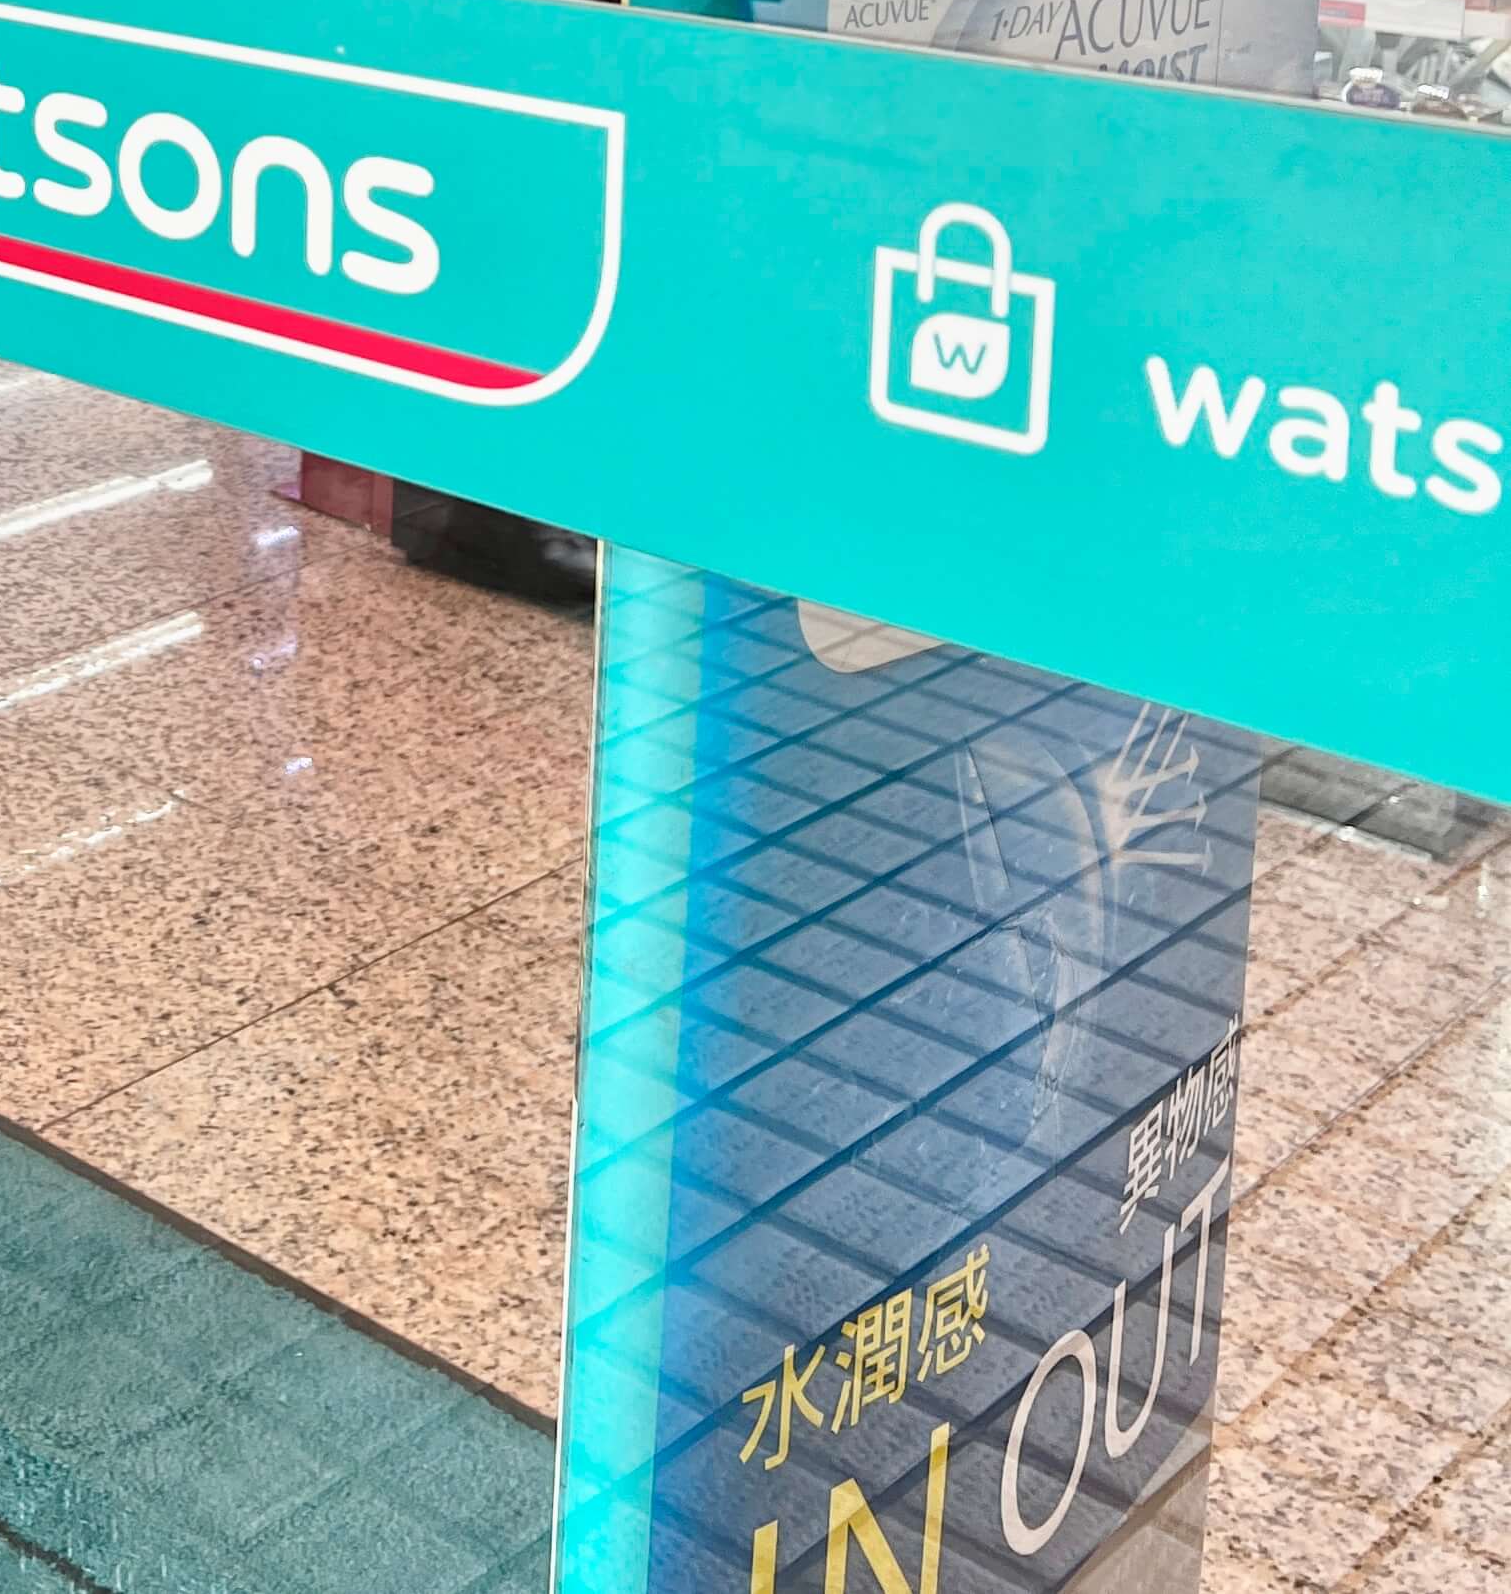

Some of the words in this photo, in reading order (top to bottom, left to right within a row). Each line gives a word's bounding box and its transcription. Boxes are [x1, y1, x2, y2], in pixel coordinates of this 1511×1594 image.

[1097, 42, 1210, 85] OIST
[1145, 355, 1504, 516] wats
[1120, 1014, 1240, 1235] 異物感
[739, 1243, 992, 1471] 水潤感
[1001, 1157, 1230, 1557] OUT
